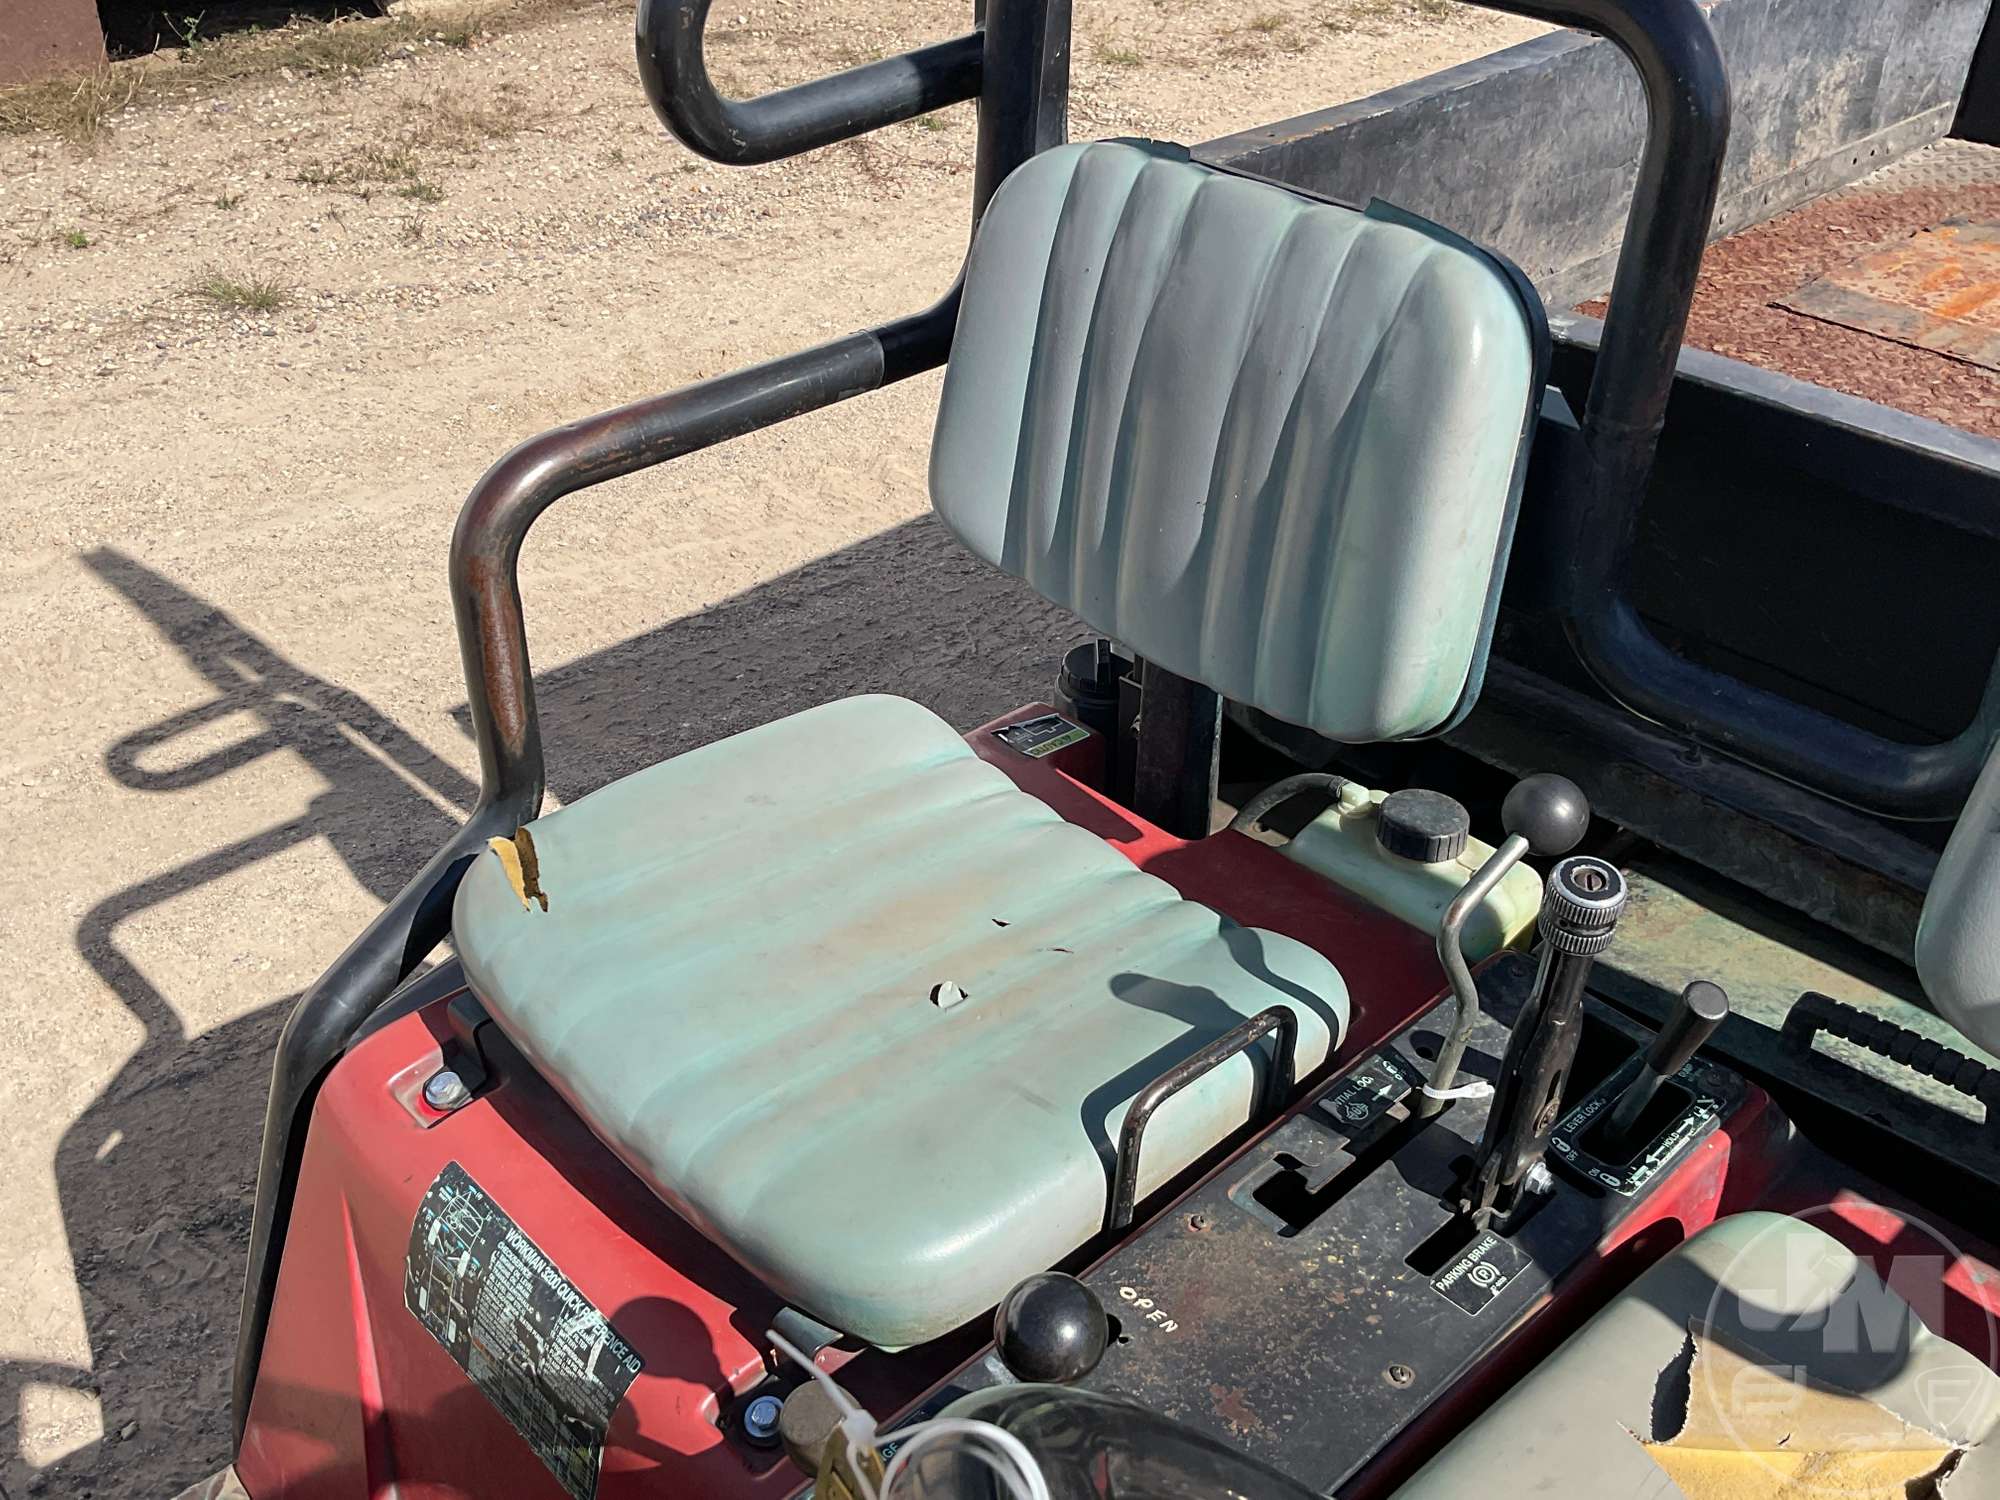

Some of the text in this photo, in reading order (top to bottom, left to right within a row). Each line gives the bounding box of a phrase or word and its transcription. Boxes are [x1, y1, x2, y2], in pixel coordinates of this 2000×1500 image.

[1562, 1112, 1587, 1133] LEVER
[1661, 1131, 1680, 1148] HOLD
[1435, 1257, 1472, 1292] PARKING
[1466, 1235, 1497, 1262] BRAKE
[504, 1226, 547, 1274] WORKMAN
[540, 1264, 562, 1291] 3200
[556, 1281, 585, 1315] QUICK
[622, 1352, 642, 1375] AID
[1119, 1285, 1181, 1334] OPEN
